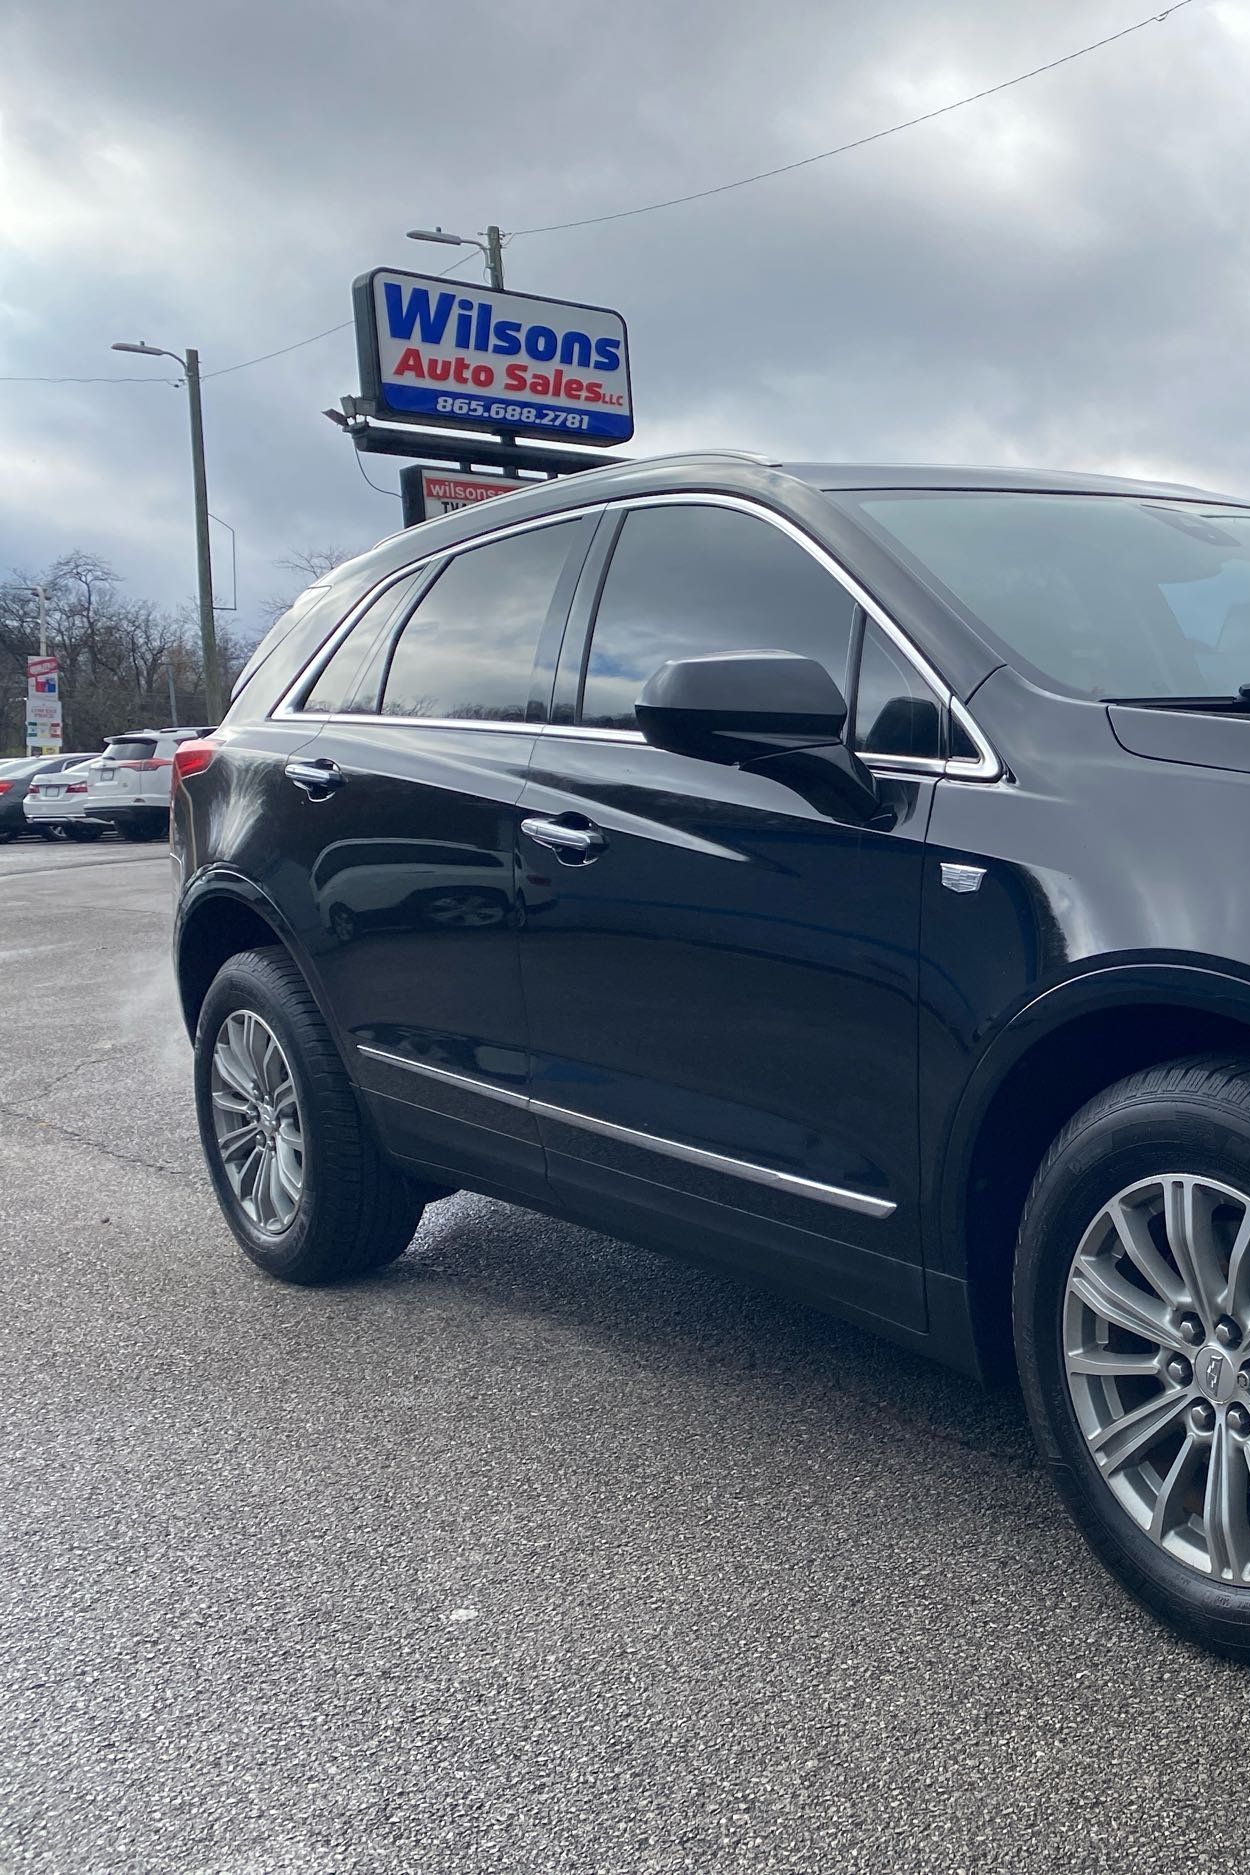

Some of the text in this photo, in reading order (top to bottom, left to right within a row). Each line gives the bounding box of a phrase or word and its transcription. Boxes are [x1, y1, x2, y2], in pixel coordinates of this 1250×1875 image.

[384, 282, 621, 371] Wilsons
[393, 347, 623, 406] Auto Sales LLC
[436, 397, 589, 430] 865.688.2781
